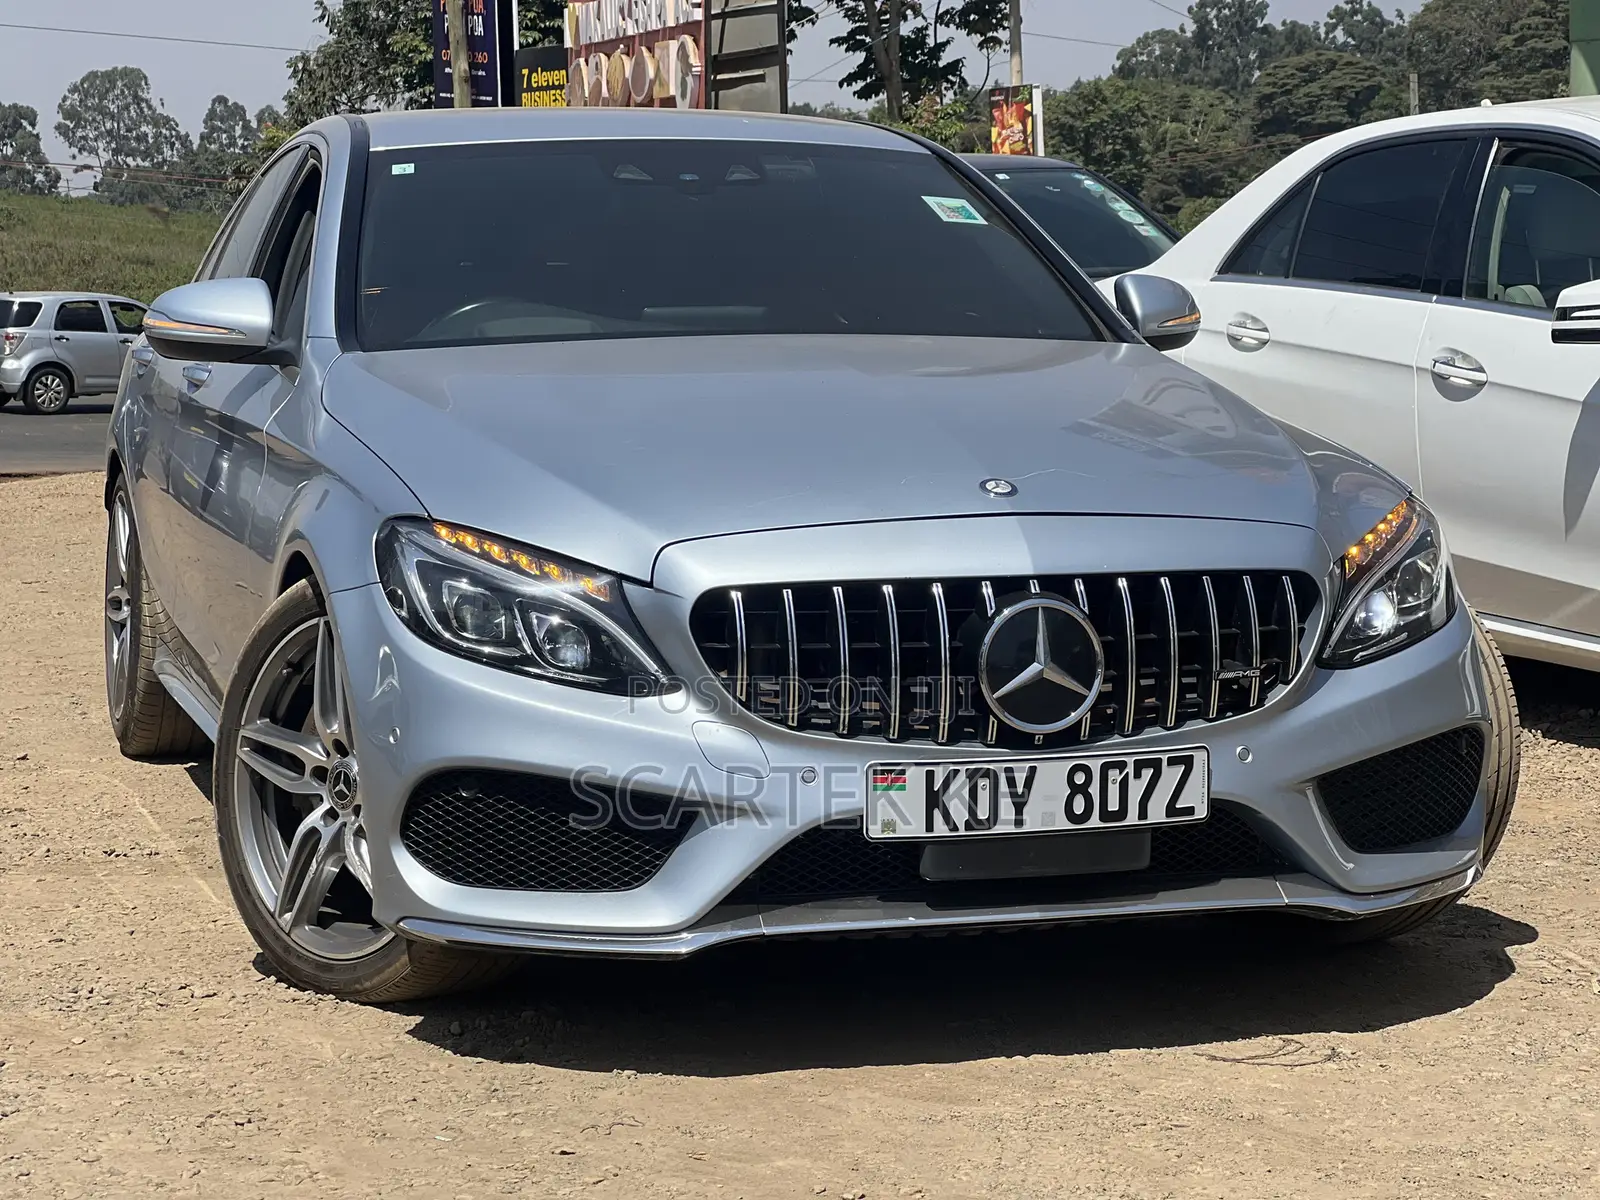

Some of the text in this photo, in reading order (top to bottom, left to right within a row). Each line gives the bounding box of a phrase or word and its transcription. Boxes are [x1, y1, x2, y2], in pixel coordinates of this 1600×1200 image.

[468, 15, 484, 36] POA
[474, 52, 489, 64] 260
[522, 66, 567, 89] 7 eleven
[521, 89, 567, 108] BUSINESS
[1234, 669, 1261, 678] AMG
[925, 764, 1037, 833] KDY
[1063, 753, 1196, 826] 807Z
